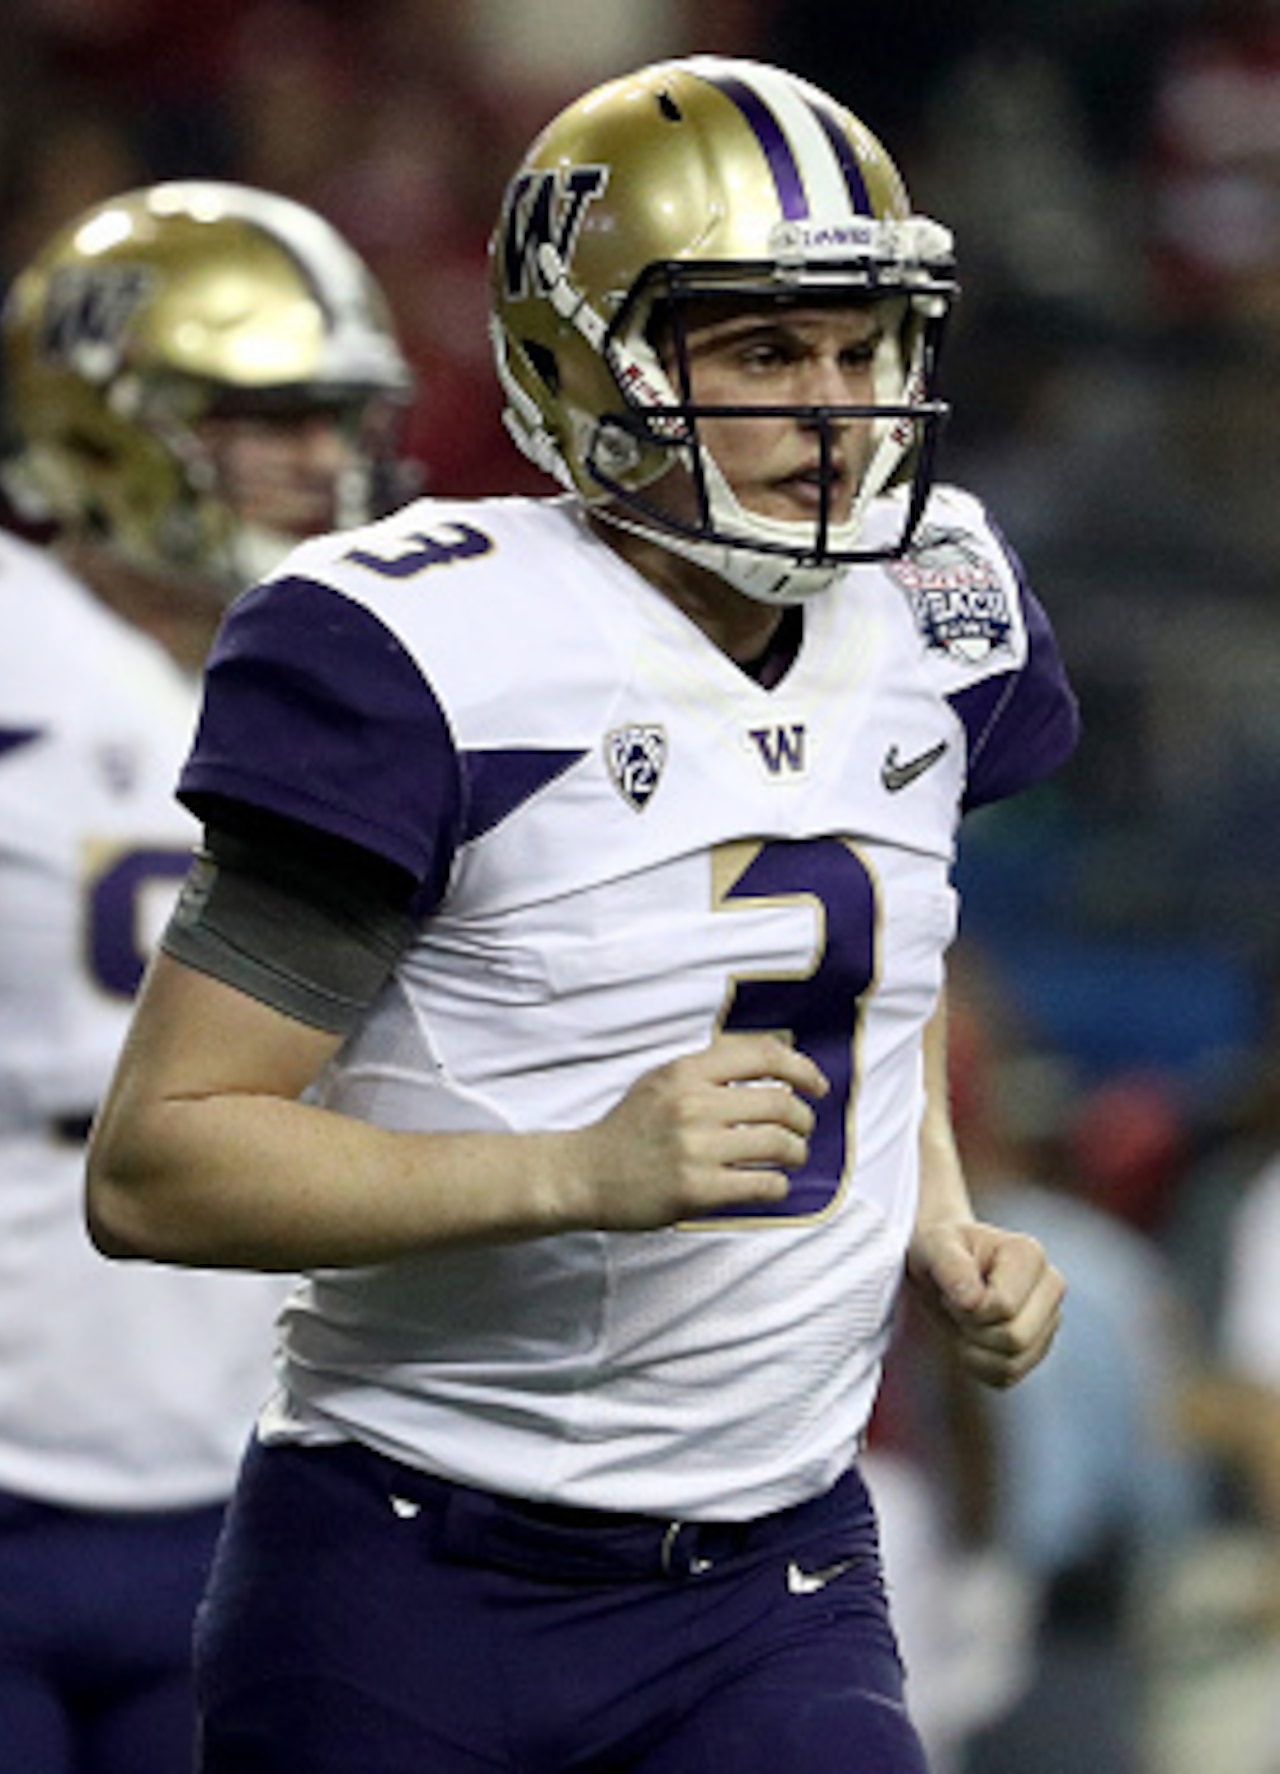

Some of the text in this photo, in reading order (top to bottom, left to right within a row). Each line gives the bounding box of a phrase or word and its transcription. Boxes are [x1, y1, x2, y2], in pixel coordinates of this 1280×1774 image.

[503, 163, 609, 302] W
[747, 723, 807, 777] W
[675, 836, 885, 1232] 3
